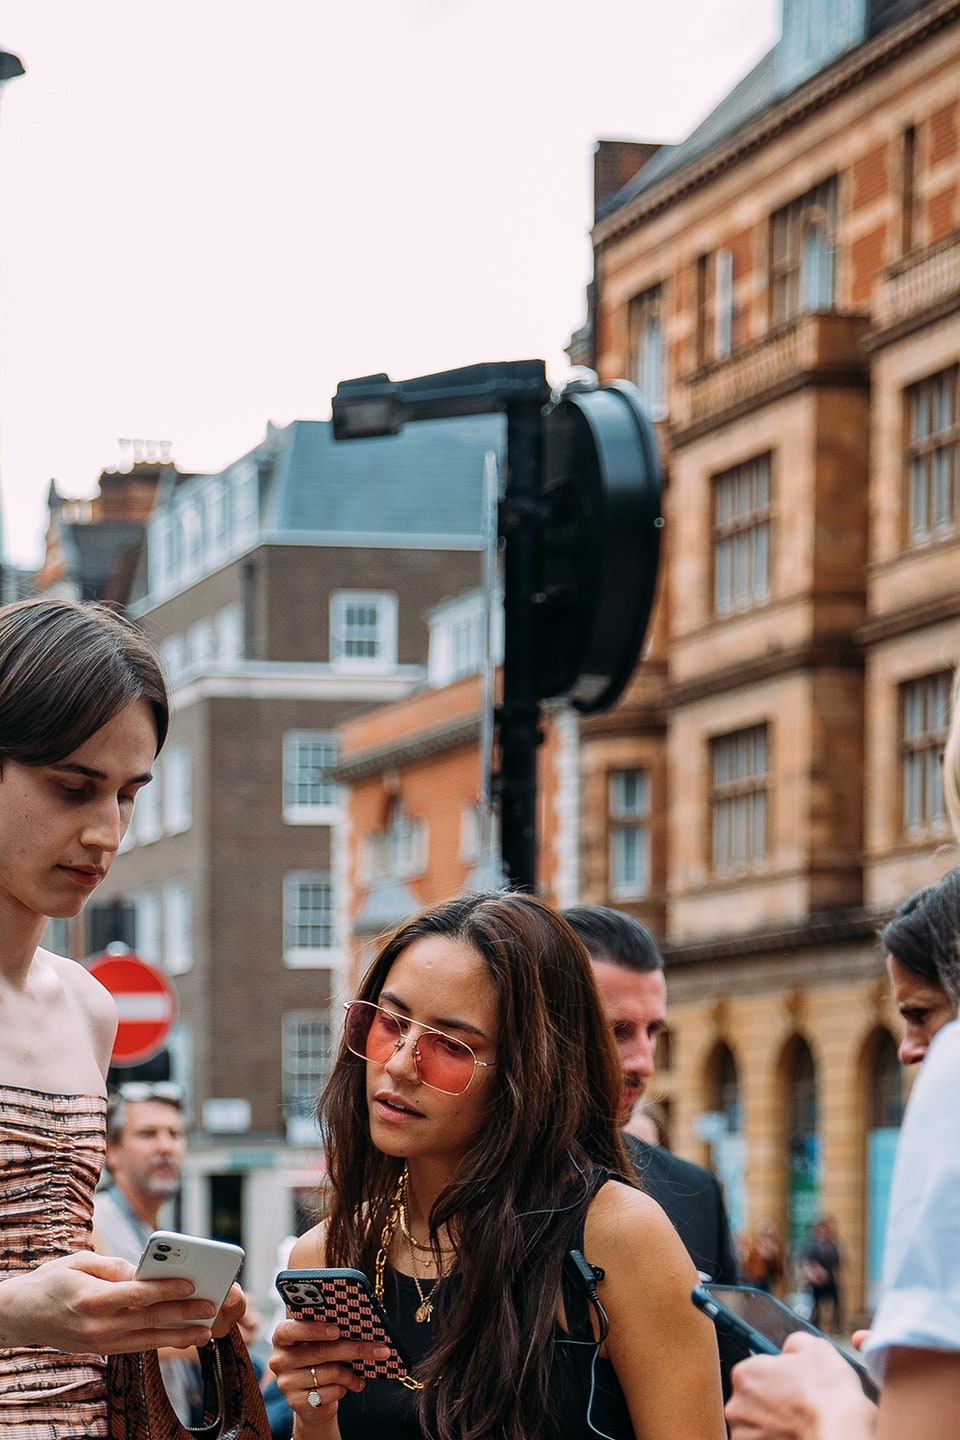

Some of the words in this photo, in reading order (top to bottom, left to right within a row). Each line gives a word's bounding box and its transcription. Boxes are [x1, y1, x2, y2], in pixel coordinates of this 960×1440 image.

[322, 1283, 335, 1291] ND
[346, 1286, 358, 1294] ND
[335, 1291, 347, 1299] ND
[347, 1299, 359, 1307] ND
[336, 1304, 348, 1312] ND
[359, 1307, 372, 1315] ND
[325, 1309, 337, 1317] ND
[348, 1312, 360, 1320] ND
[314, 1314, 326, 1322] ND
[337, 1317, 349, 1325] ND
[360, 1320, 372, 1328] ND
[349, 1325, 361, 1333] ND
[372, 1328, 384, 1336] ND
[361, 1333, 373, 1341] ND
[352, 1362, 364, 1370] ND
[364, 1370, 376, 1378] ND
